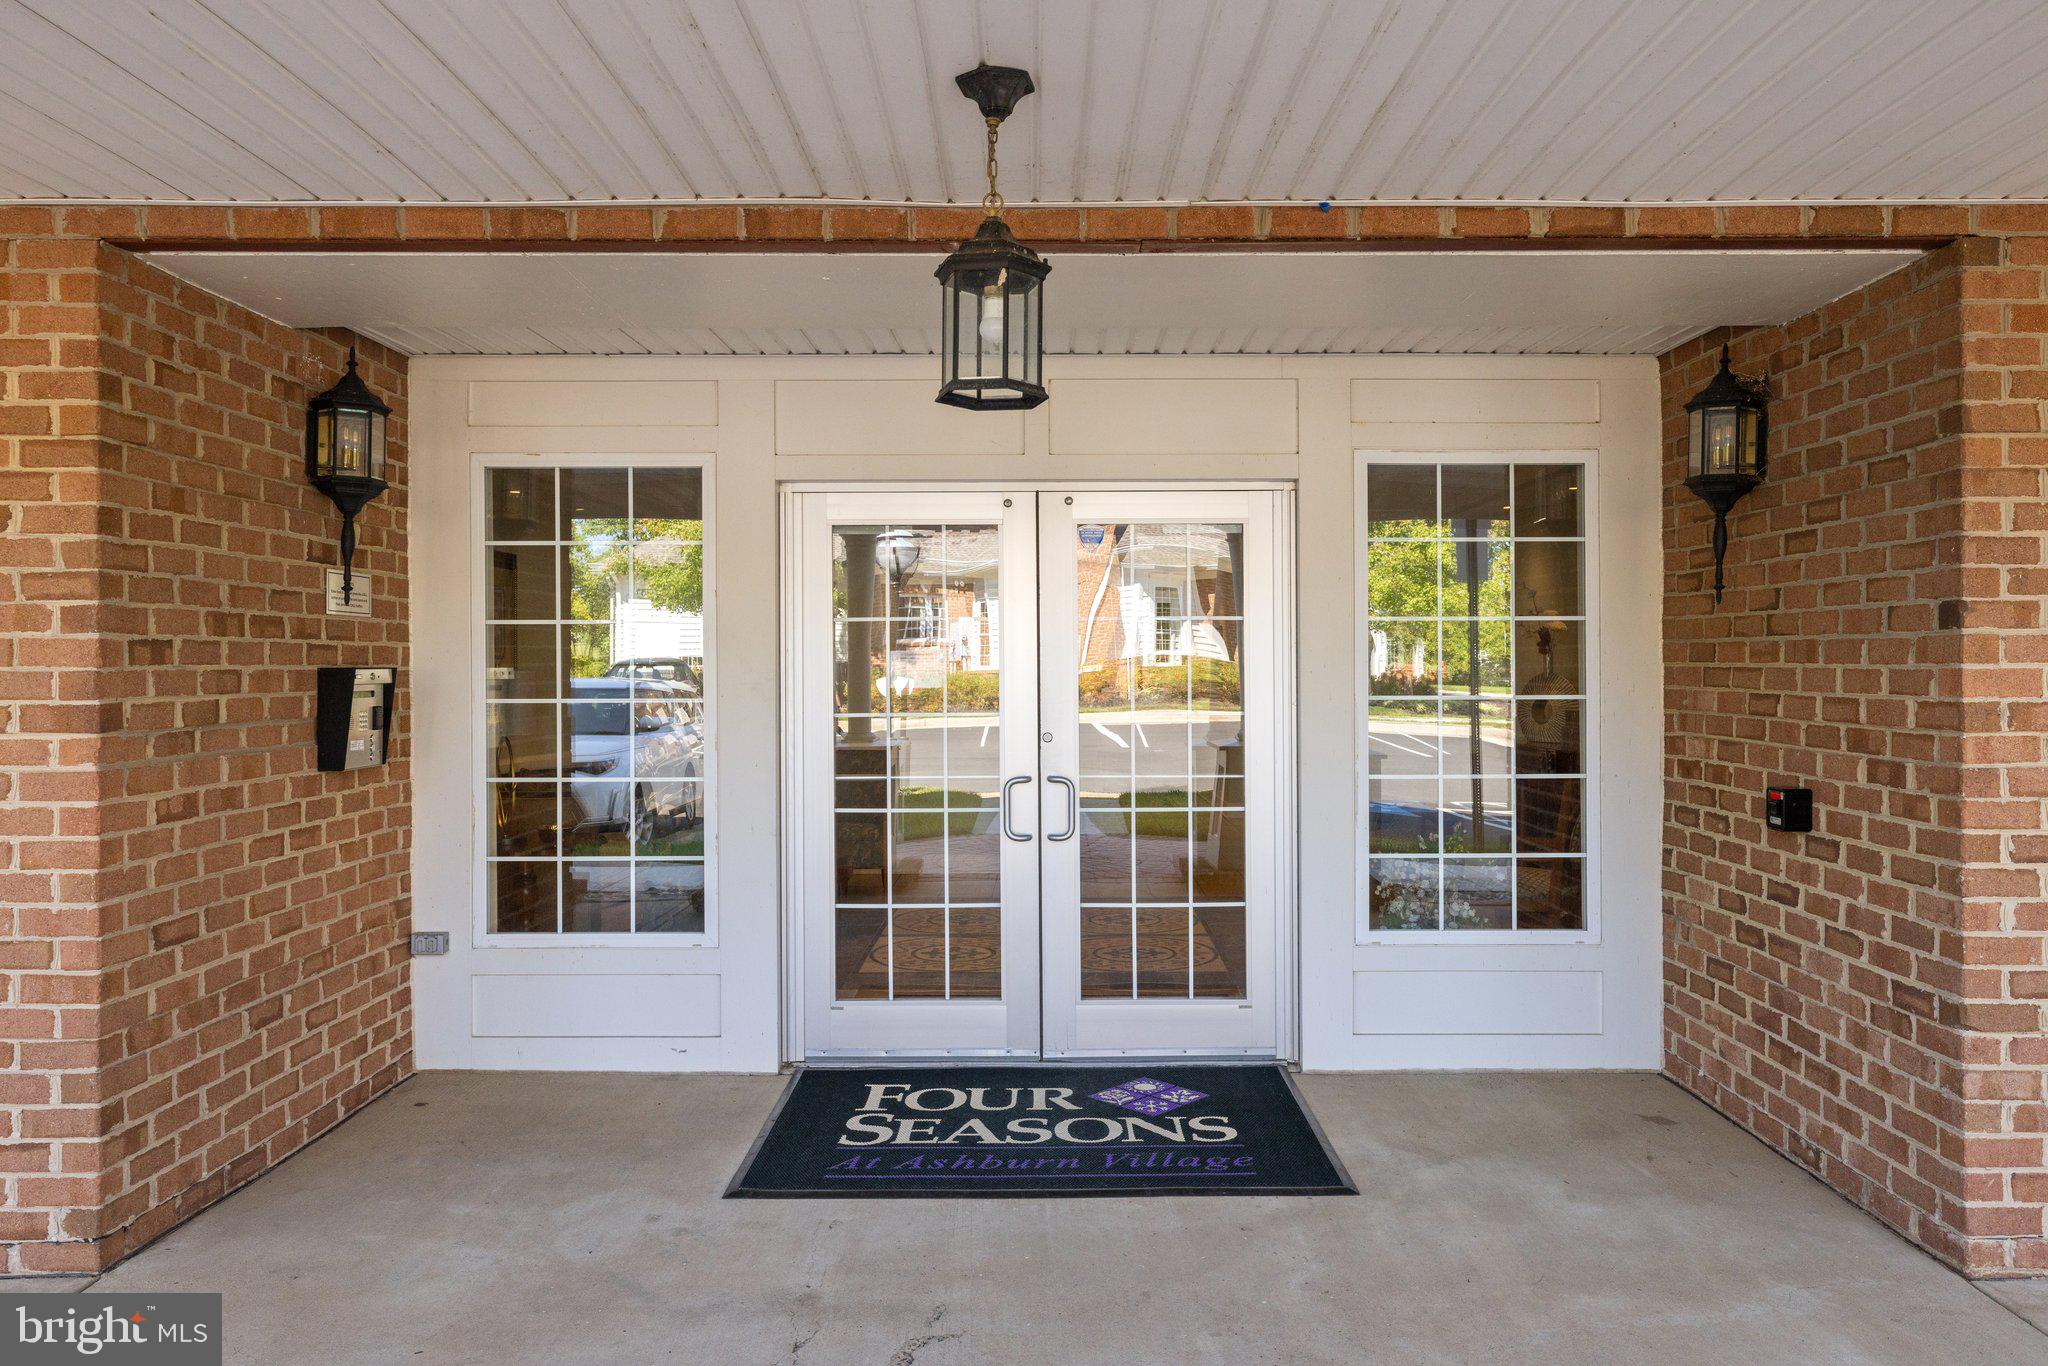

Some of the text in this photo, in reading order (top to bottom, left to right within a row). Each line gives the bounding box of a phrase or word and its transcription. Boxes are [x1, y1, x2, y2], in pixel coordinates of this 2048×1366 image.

[855, 1083, 1083, 1112] FOUR
[838, 1113, 1238, 1146] SEASONS
[827, 1152, 1254, 1171] At Ashburn Village
